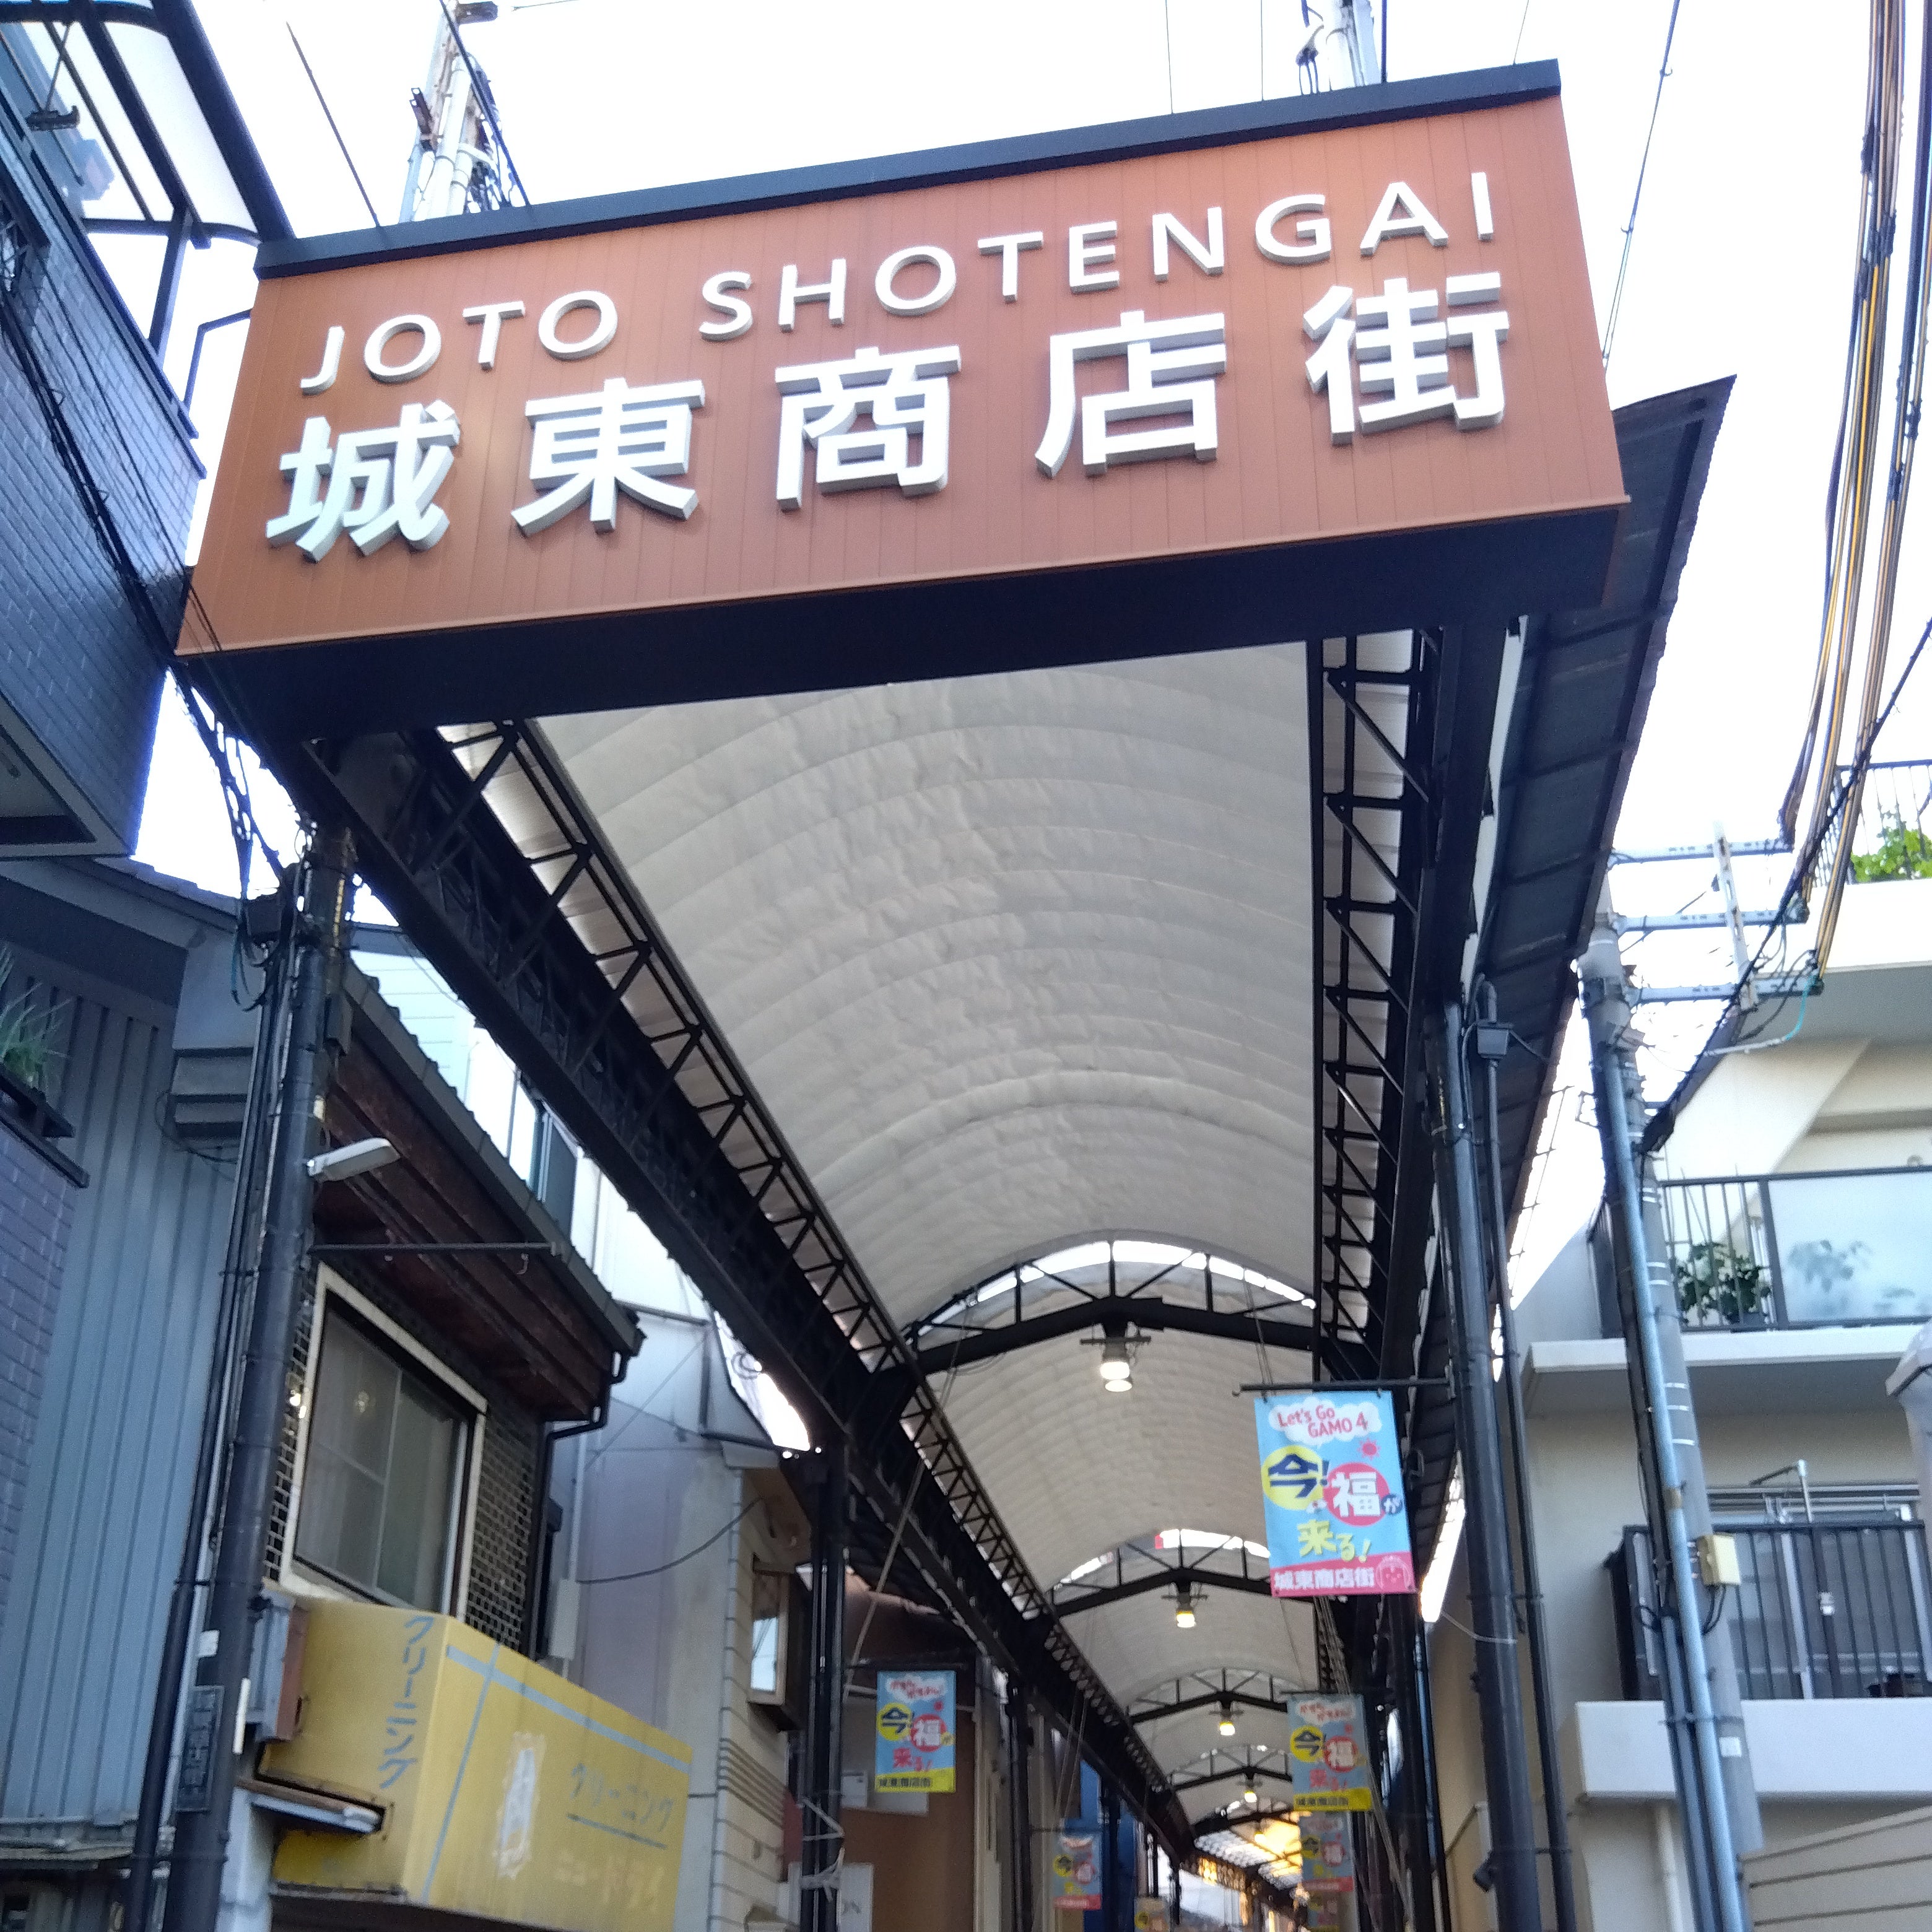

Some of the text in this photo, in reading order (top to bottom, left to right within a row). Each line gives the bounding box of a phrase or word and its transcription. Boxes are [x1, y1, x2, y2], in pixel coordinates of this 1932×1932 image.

[300, 172, 1494, 396] JOTO SHOTENGAI
[266, 271, 1510, 563] 城東商店街
[1307, 1417, 1353, 1438] GAMO
[1315, 1404, 1336, 1421] Go
